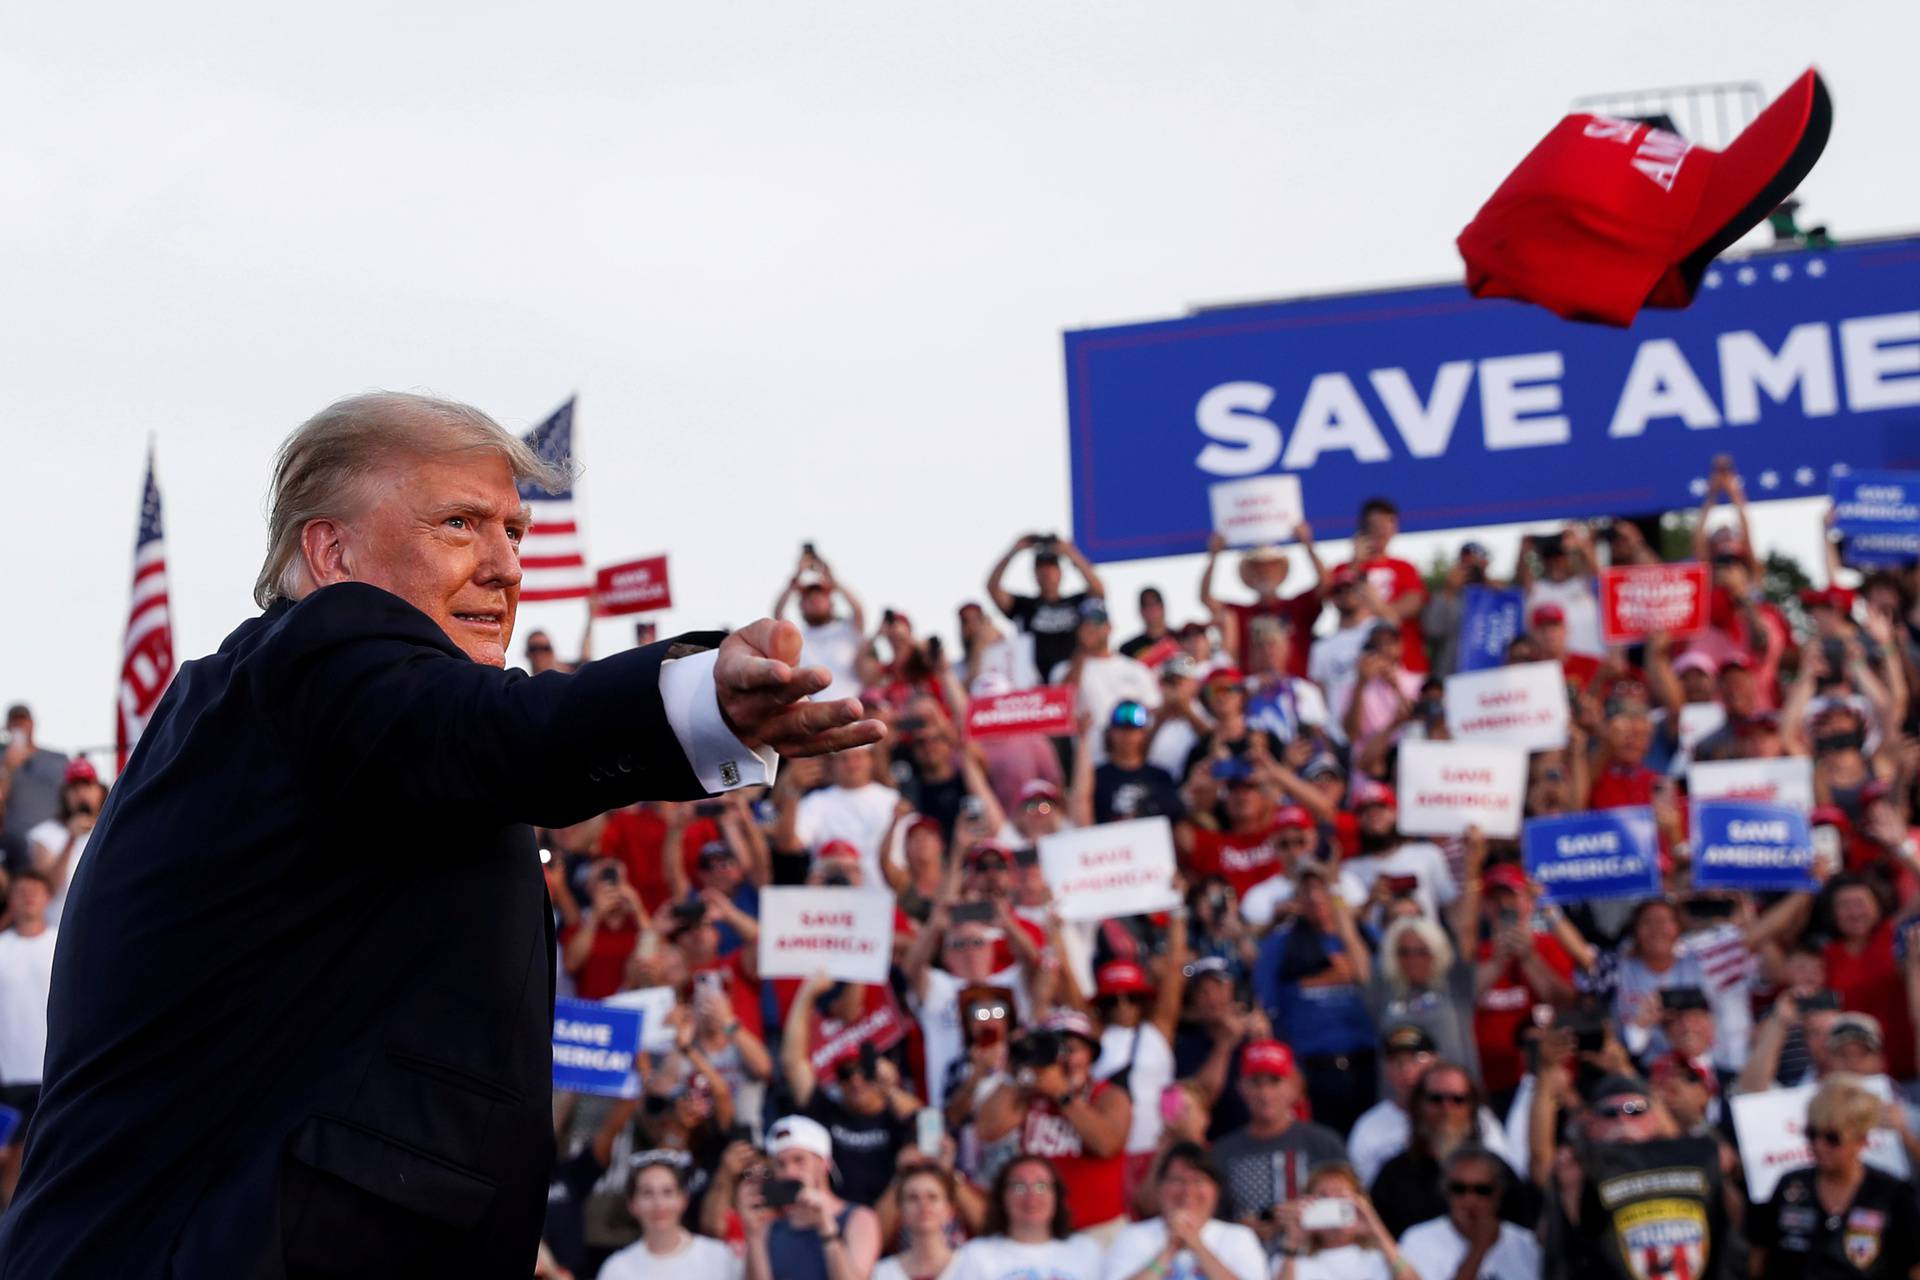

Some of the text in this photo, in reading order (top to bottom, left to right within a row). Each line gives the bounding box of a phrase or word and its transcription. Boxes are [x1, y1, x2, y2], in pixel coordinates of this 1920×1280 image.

[1195, 311, 1920, 476] SAVE AME
[1556, 831, 1620, 857] SAVE
[1726, 820, 1790, 842] SAVE
[800, 911, 855, 928] SAVE
[555, 1019, 613, 1047] SAVE
